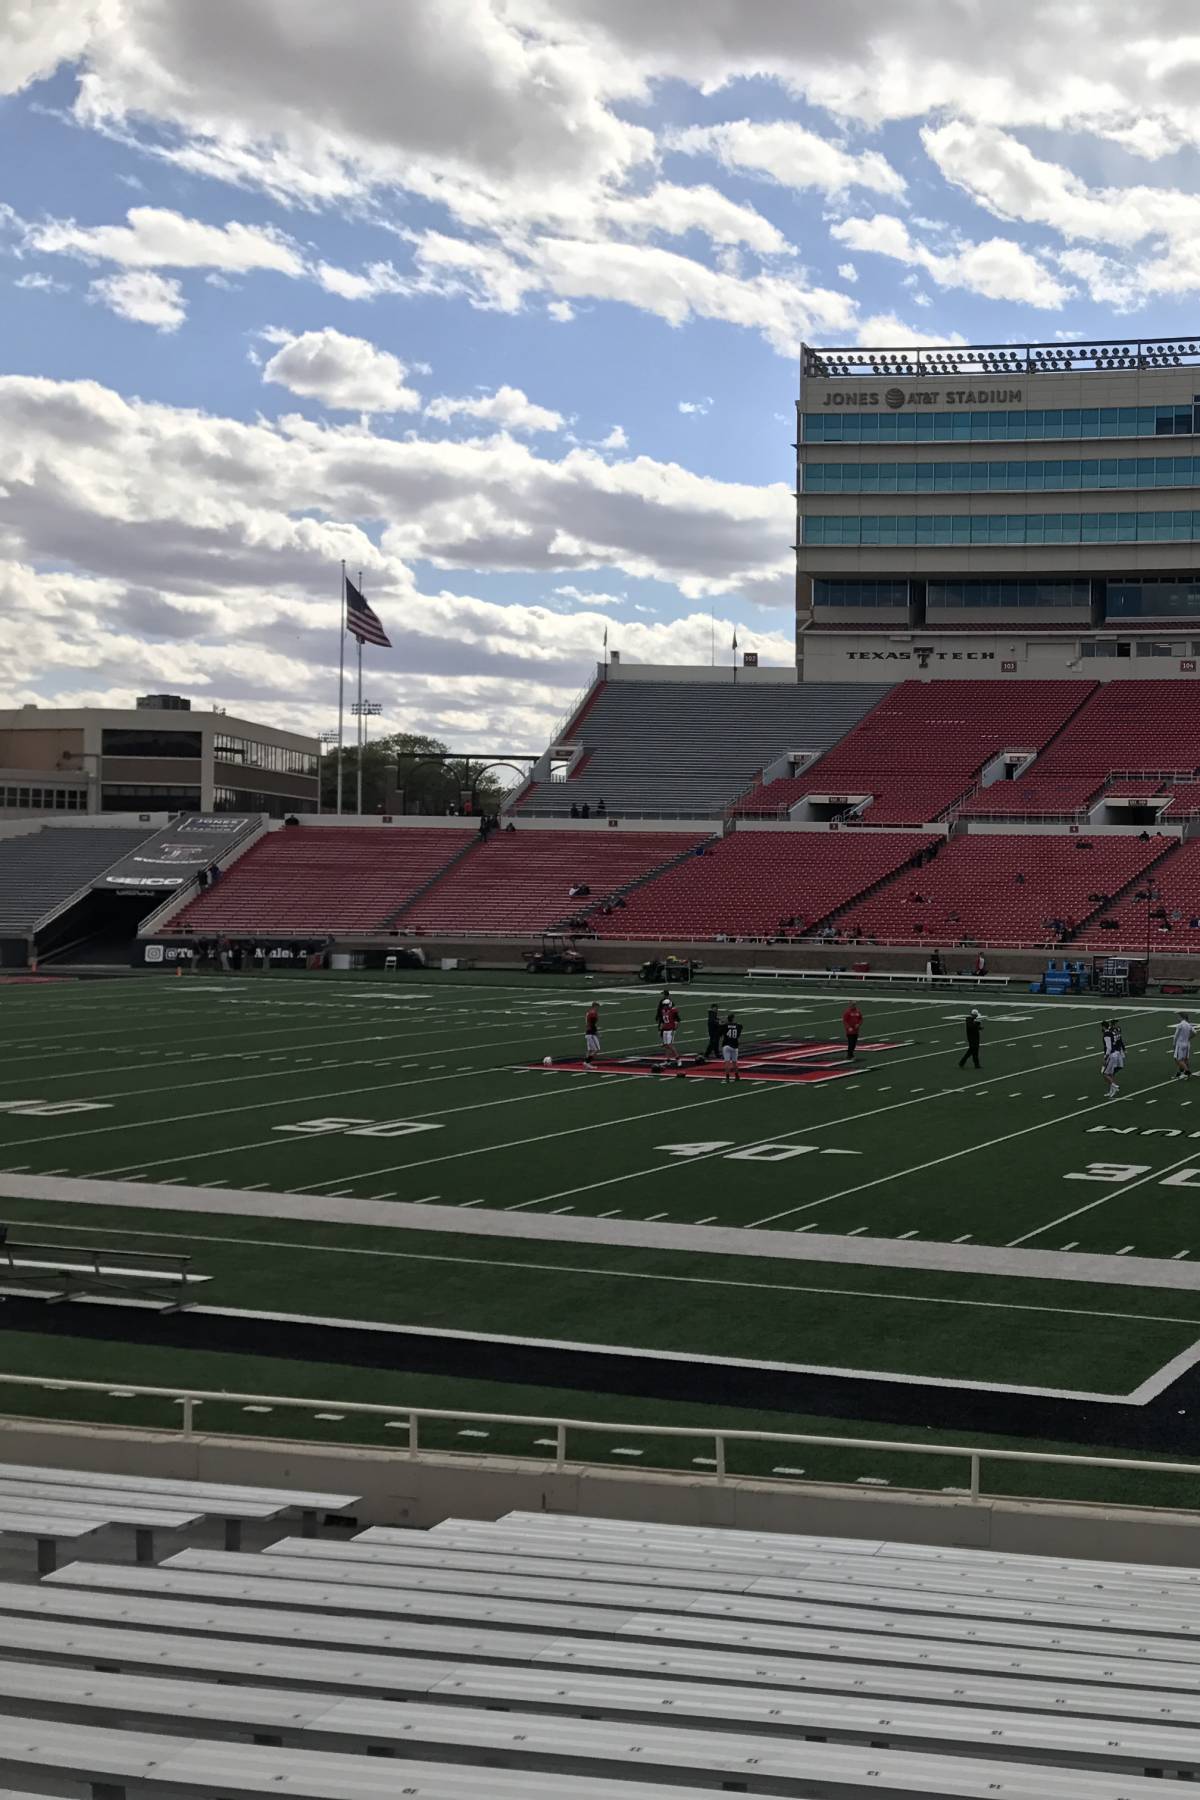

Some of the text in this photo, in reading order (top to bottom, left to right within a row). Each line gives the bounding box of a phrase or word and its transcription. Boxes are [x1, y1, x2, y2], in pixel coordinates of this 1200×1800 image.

[823, 389, 1022, 406] JONES AT&T STADIUM
[846, 651, 911, 660] TEXAS
[936, 651, 995, 660] TECH
[106, 877, 183, 886] GEICO
[726, 1029, 738, 1039] 48
[272, 1117, 446, 1138] 50
[653, 1141, 819, 1161] 40
